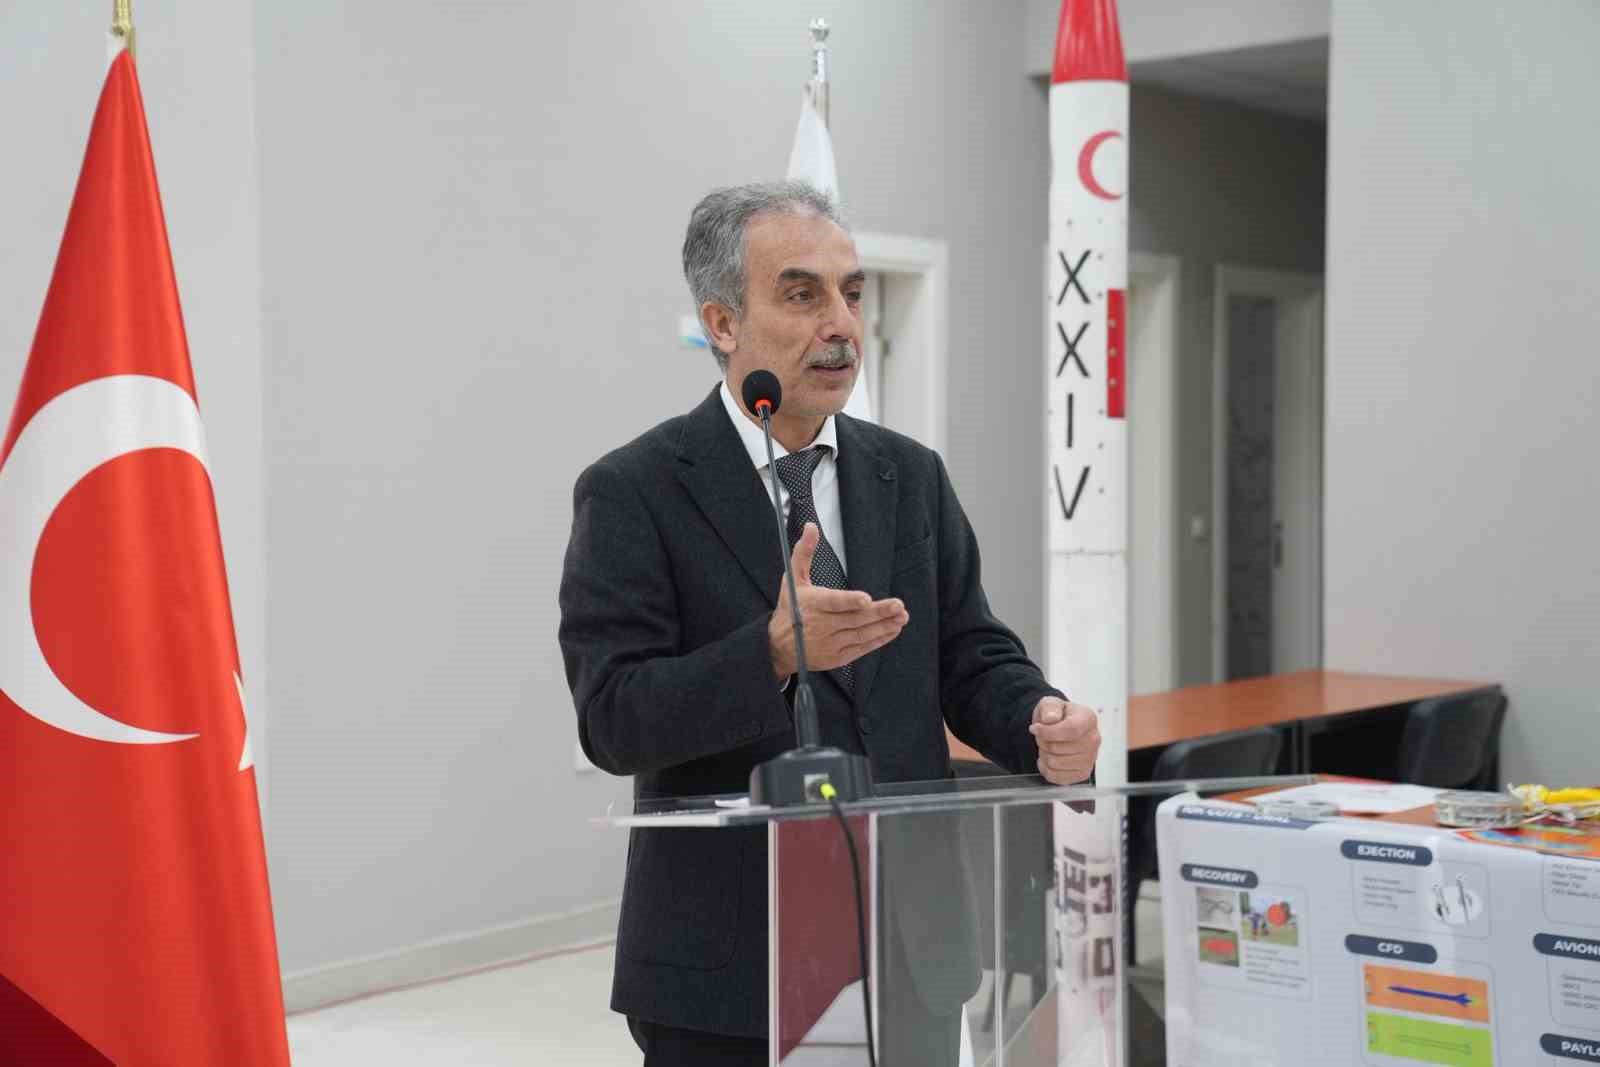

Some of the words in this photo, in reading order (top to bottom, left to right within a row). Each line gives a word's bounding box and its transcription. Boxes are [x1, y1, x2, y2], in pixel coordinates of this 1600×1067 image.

[1055, 250, 1090, 520] XXIV
[1357, 844, 1417, 861] EJECTION
[1191, 868, 1246, 883] RECOVERY
